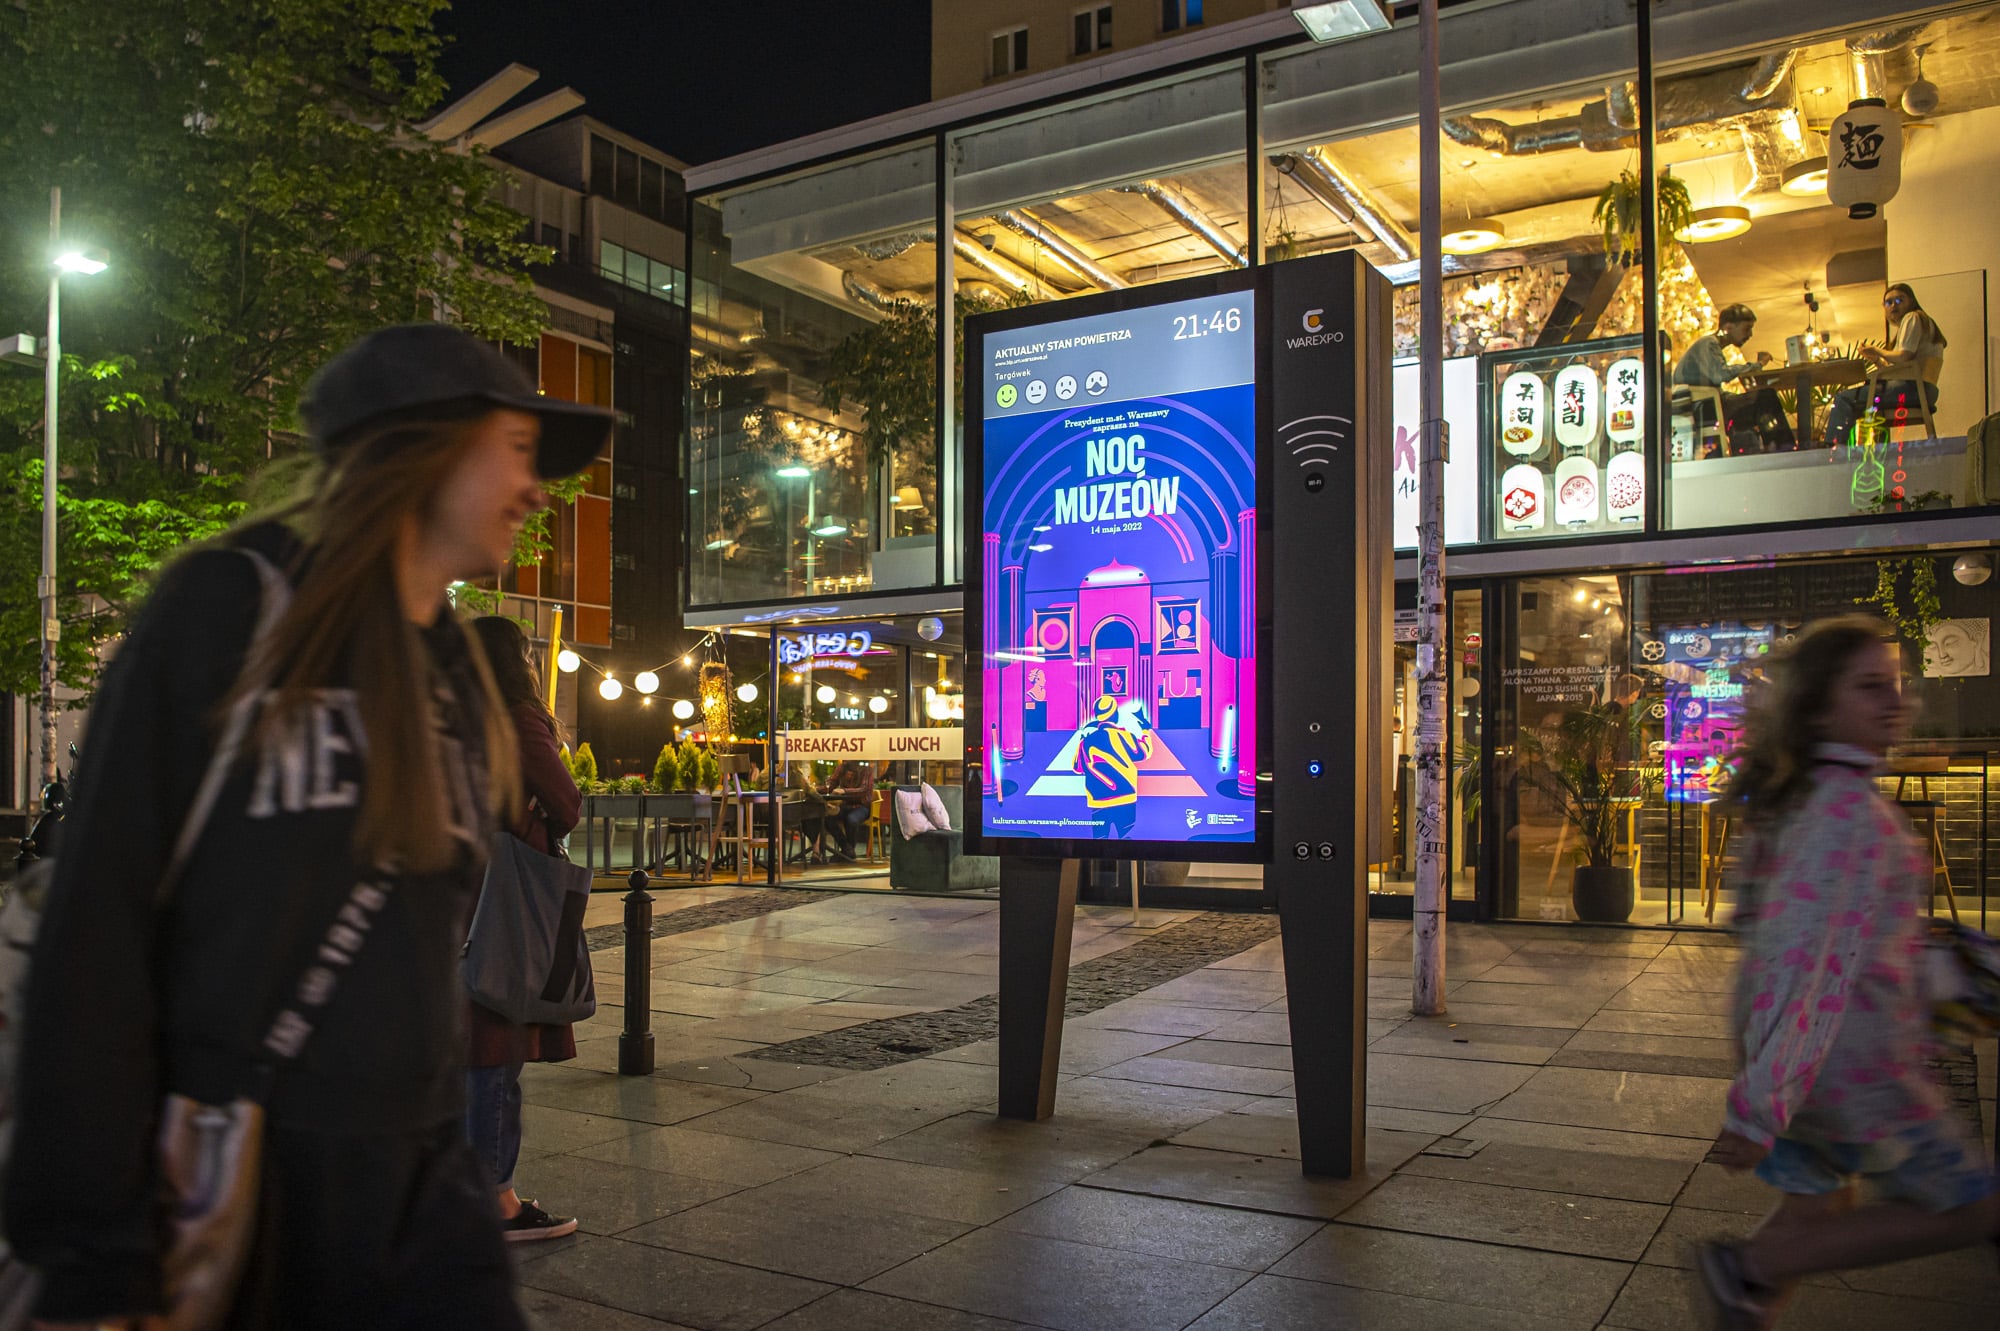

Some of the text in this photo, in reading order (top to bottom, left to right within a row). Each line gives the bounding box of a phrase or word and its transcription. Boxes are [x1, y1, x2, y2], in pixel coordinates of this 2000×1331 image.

[1173, 307, 1241, 341] 21:46
[995, 329, 1132, 359] AKTUALNY STAN POWIETRZA
[1286, 331, 1344, 349] WAREXPO
[995, 368, 1031, 381] Targówek
[1064, 416, 1104, 429] Prezydent
[1127, 409, 1170, 420] Warszawy
[1092, 422, 1127, 433] zaprasza
[1086, 434, 1145, 478] NOC
[1055, 470, 1180, 525] MUZEÓW
[1090, 522, 1143, 535] 14 maja 2022
[1534, 675, 1561, 683] THANA
[1523, 685, 1552, 693] WORLD
[785, 736, 940, 753] BREAKFAST LUNCH
